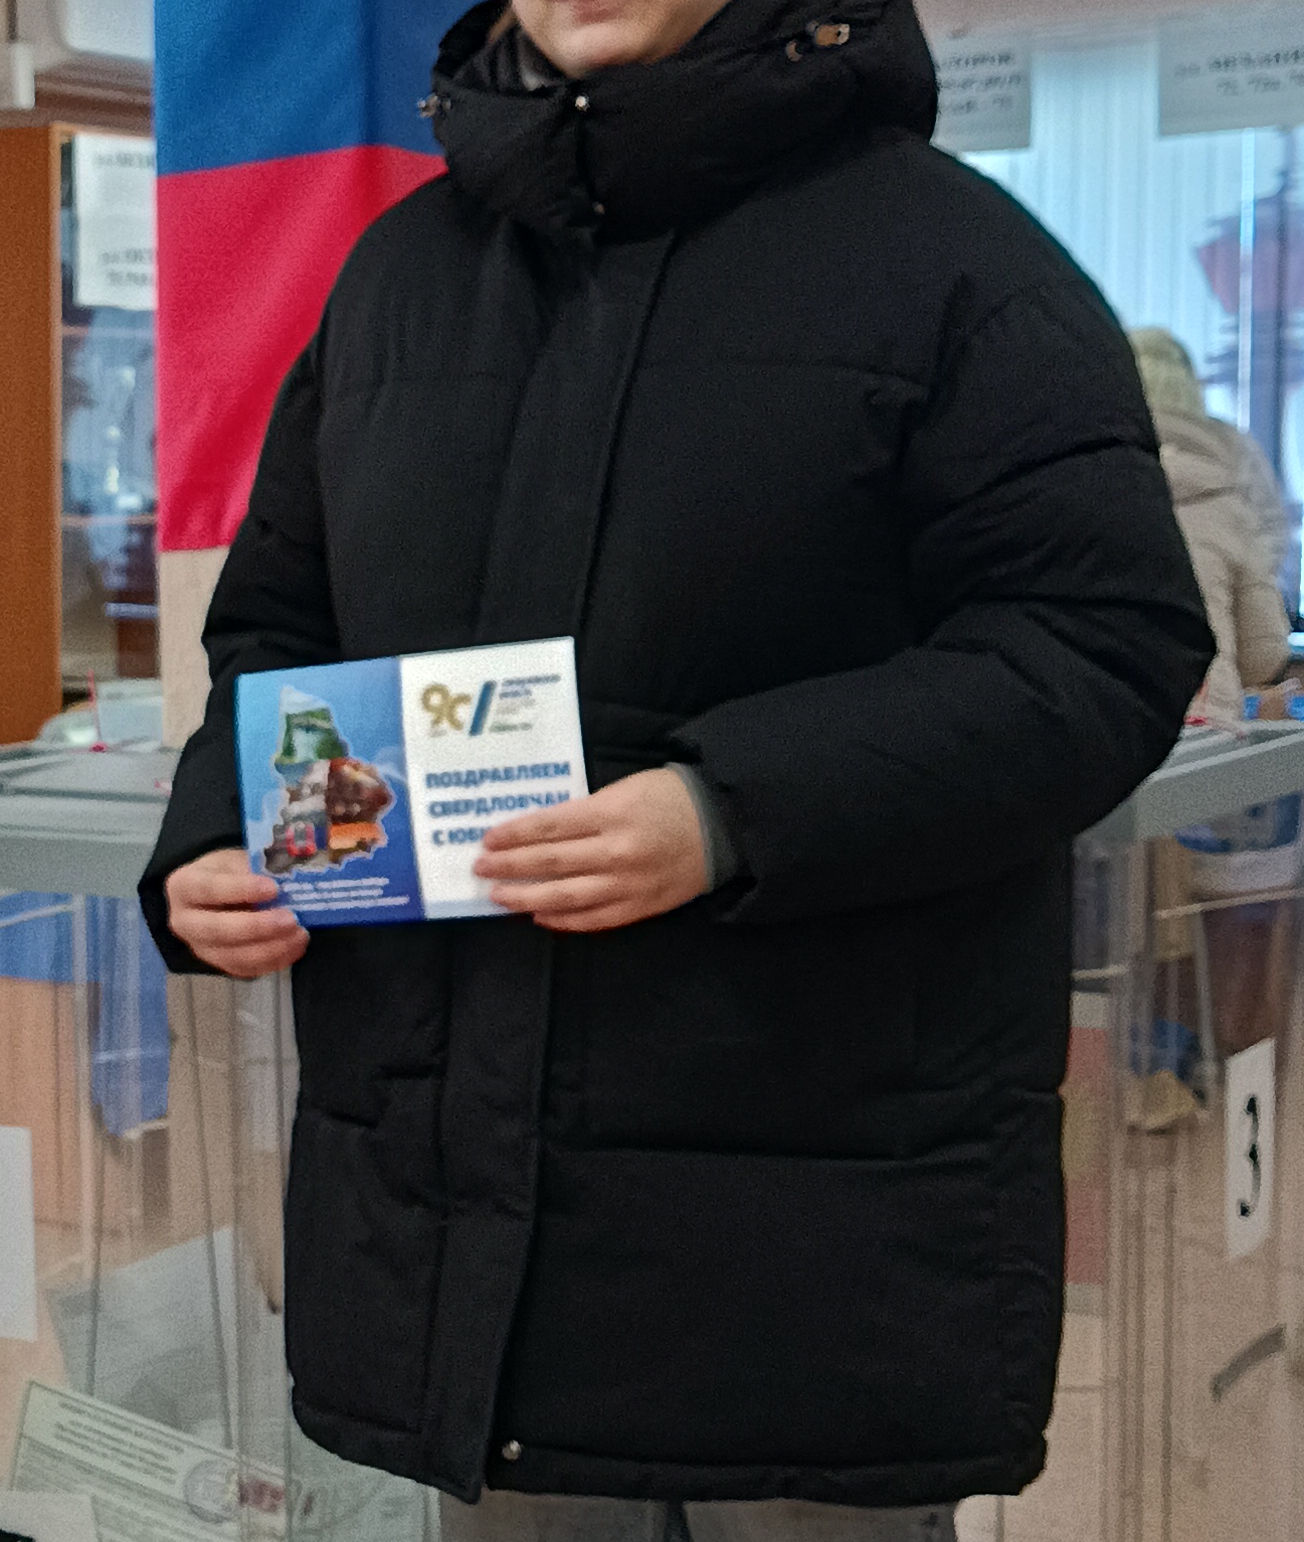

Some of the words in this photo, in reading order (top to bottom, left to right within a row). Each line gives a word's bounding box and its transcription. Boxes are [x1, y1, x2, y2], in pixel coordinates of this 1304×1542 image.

[426, 761, 571, 789] ПОЗДРАВЛЯЕМ
[432, 829, 444, 846] С
[1237, 1093, 1262, 1219] 3
